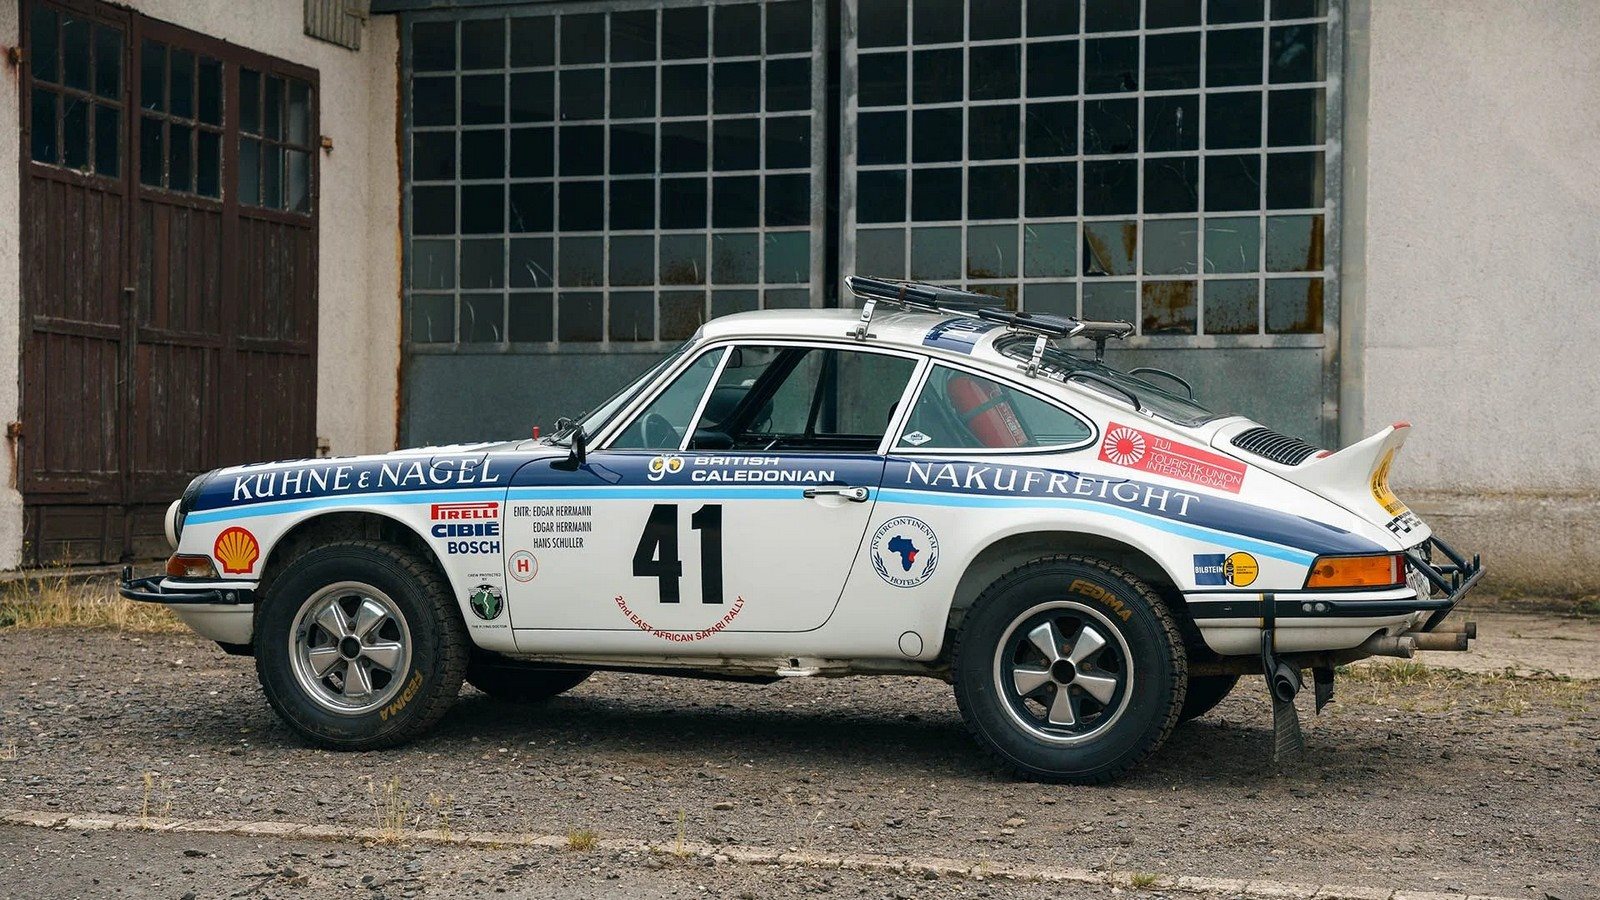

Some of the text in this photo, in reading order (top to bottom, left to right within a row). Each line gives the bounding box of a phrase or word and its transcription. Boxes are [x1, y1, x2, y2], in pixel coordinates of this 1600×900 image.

[1154, 438, 1172, 451] TUI
[647, 454, 686, 482] go
[693, 456, 780, 466] BRITISH
[1149, 451, 1243, 485] TOURISTIK UNION
[231, 465, 354, 501] KÜHNE
[377, 458, 500, 488] NAGEL
[691, 470, 835, 483] CALEDONIAN
[1146, 461, 1230, 489] INTERNATIONAL
[905, 461, 1201, 517] NAKUFREIGHT
[430, 501, 499, 520] PIRELLI
[513, 506, 592, 518] ENTR: EDGAR HERRMANN
[532, 522, 592, 533] EDGAR HERRMANN
[872, 518, 937, 550] INTERCONTINENTAL
[447, 540, 501, 555] BOSCH
[533, 538, 584, 549] HANS SCHULLER
[632, 503, 724, 605] 41
[517, 559, 530, 573] H
[1194, 565, 1224, 574] BILSTEIN
[889, 576, 921, 586] HOTELS
[1067, 578, 1133, 622] FEDIMA
[614, 595, 746, 642] 22nd EAST AFRICAN SAFARI RALLY
[379, 668, 424, 722] FEDIMA
